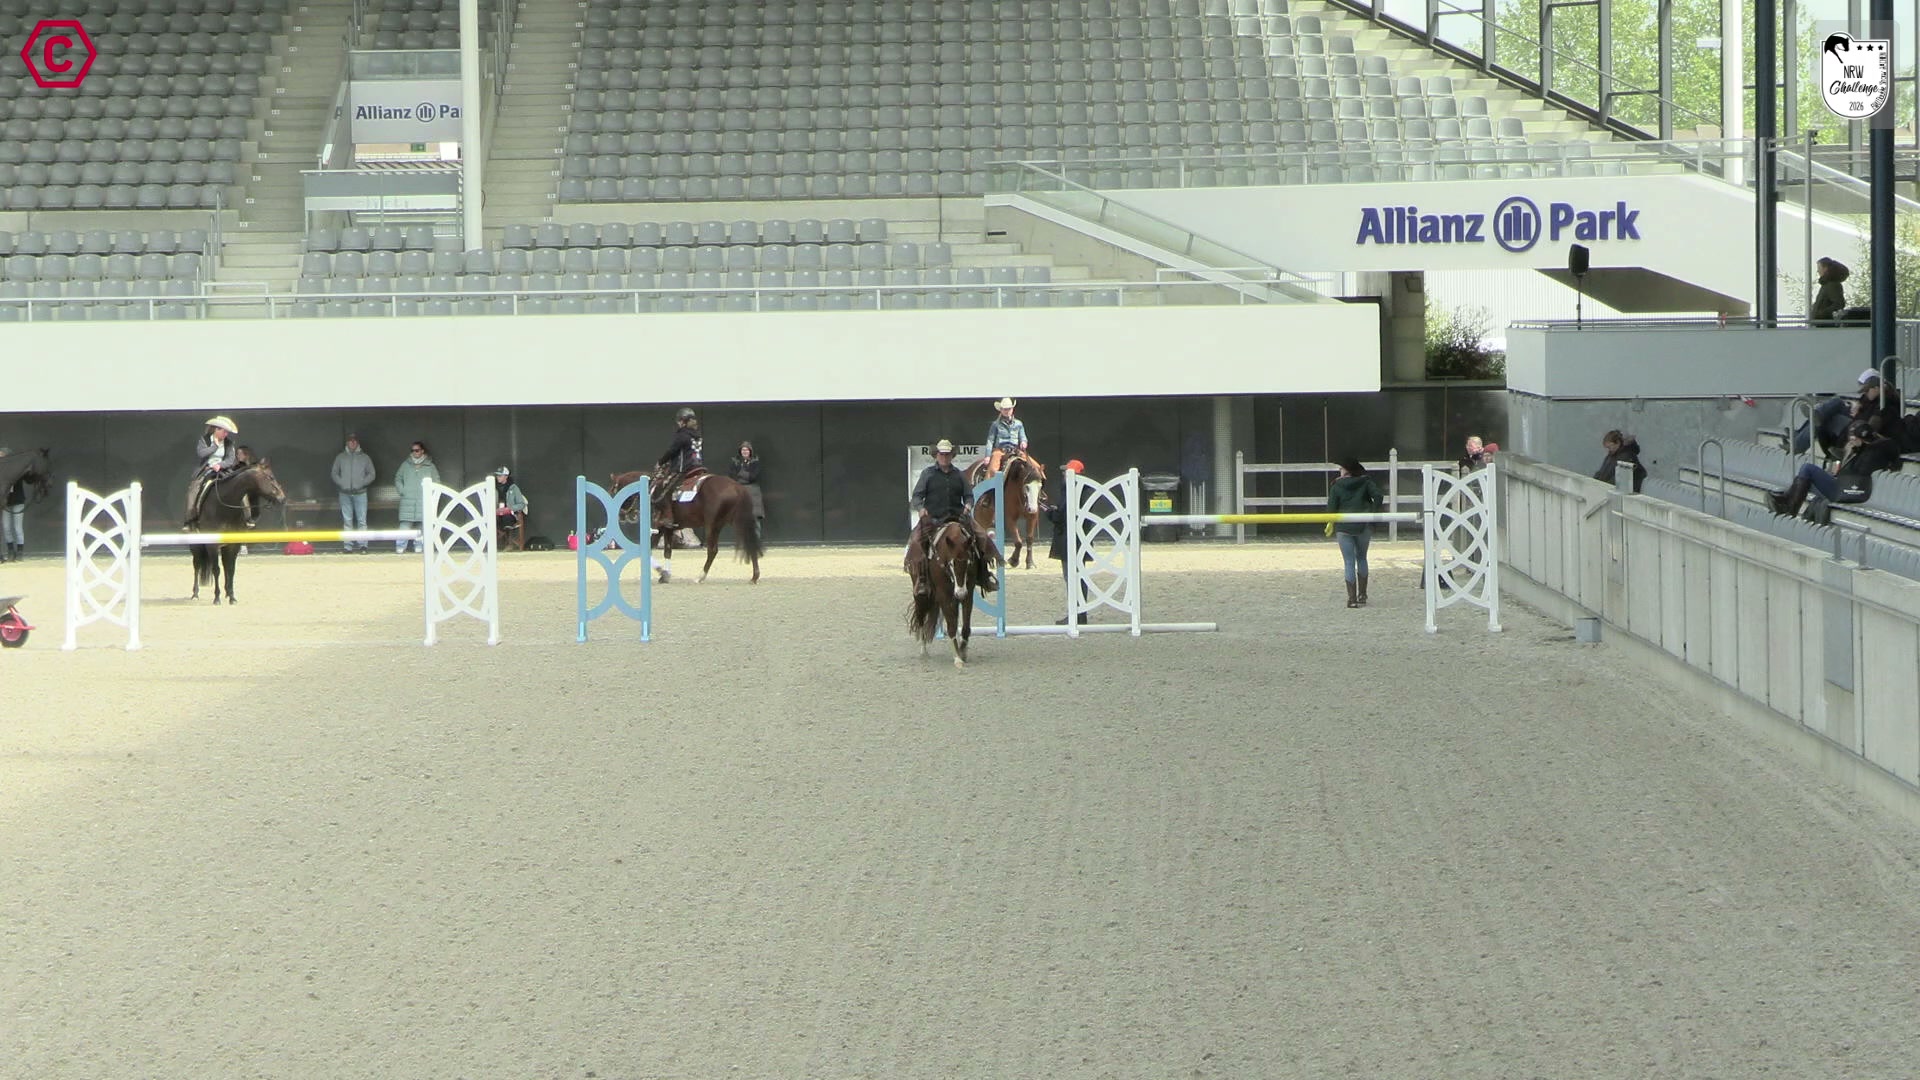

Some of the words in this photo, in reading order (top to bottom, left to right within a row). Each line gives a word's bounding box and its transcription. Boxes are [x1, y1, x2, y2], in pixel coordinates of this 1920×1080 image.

[355, 105, 412, 120] Allianz
[439, 104, 463, 119] Pa
[1356, 206, 1485, 245] Allianz
[1550, 201, 1641, 241] Park
[958, 446, 979, 455] LIVE
